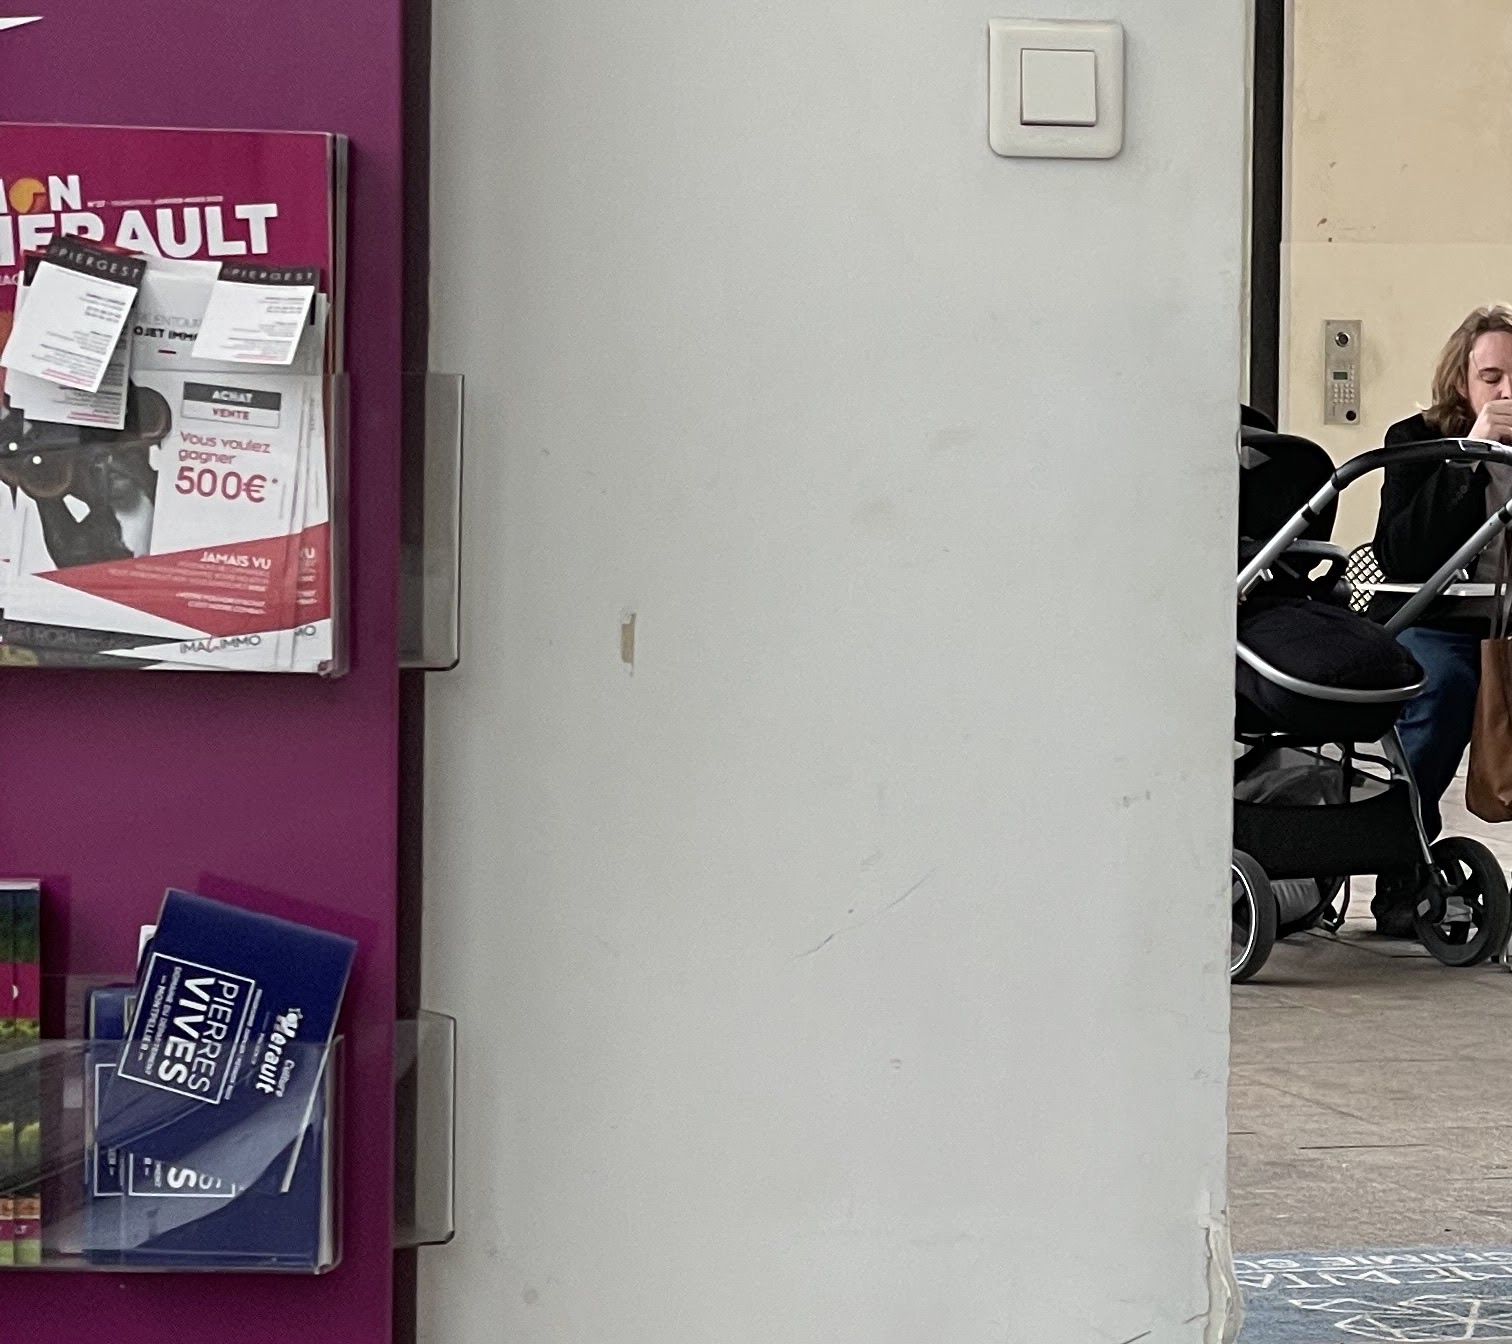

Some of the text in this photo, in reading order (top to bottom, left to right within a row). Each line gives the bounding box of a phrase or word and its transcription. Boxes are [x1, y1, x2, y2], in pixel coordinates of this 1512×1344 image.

[212, 390, 253, 403] ACHAT
[212, 408, 250, 421] VENTE
[180, 431, 271, 454] Vous voulez
[178, 449, 236, 464] gagner
[200, 551, 271, 570] JAMAIS VU
[158, 977, 217, 1084] VIVES
[187, 979, 240, 1092] PIERRES
